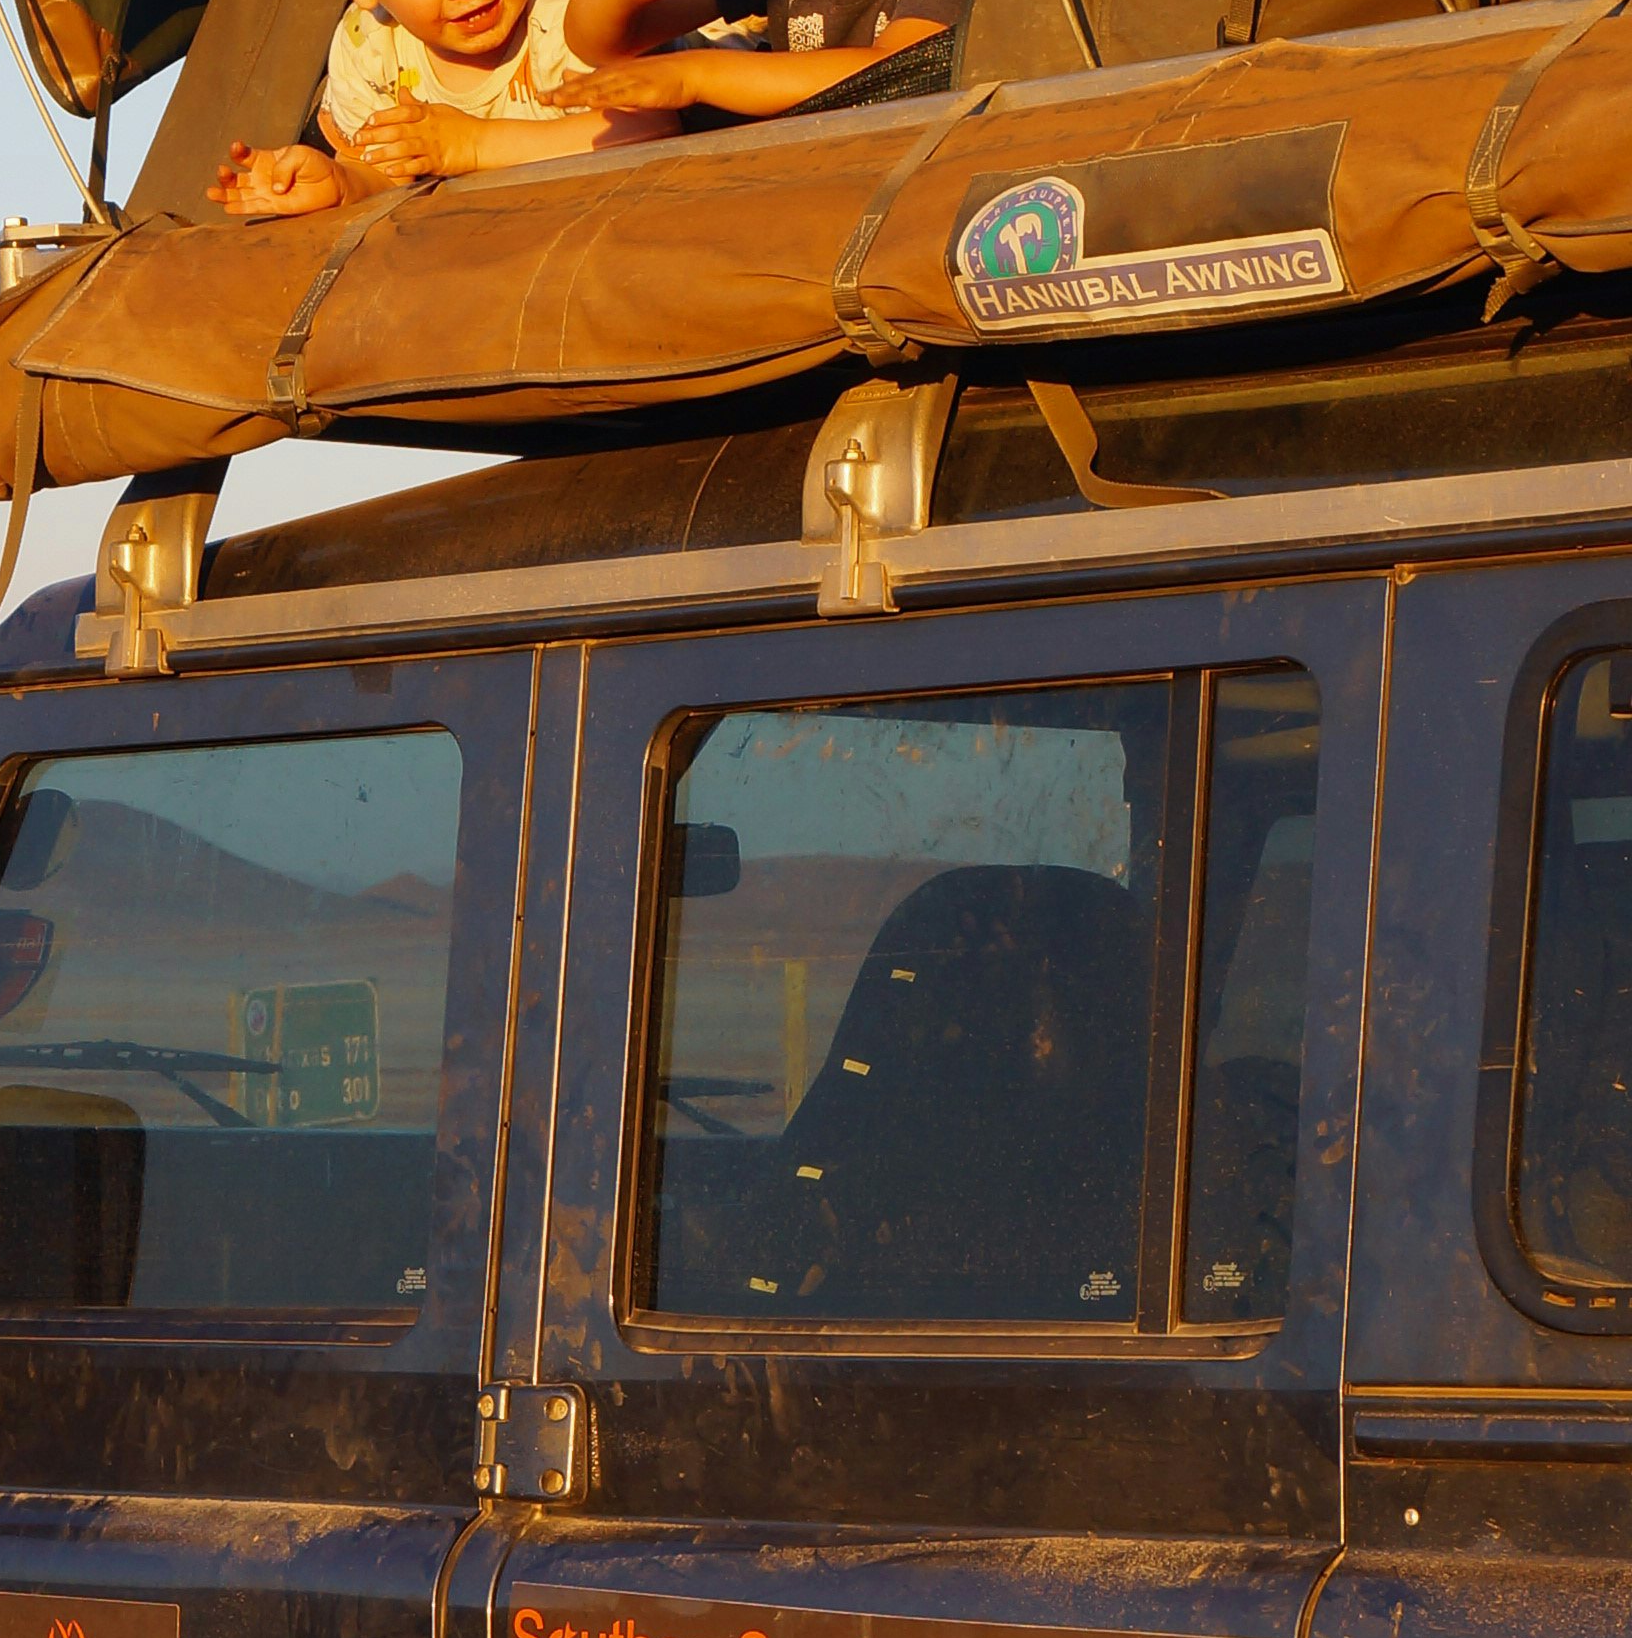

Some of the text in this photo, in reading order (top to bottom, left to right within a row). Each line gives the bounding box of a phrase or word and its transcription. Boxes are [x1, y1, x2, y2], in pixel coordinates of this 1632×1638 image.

[970, 189, 1071, 274] SAFARI EQUIPMENT
[970, 250, 1322, 316] HANNIBAL AWNING
